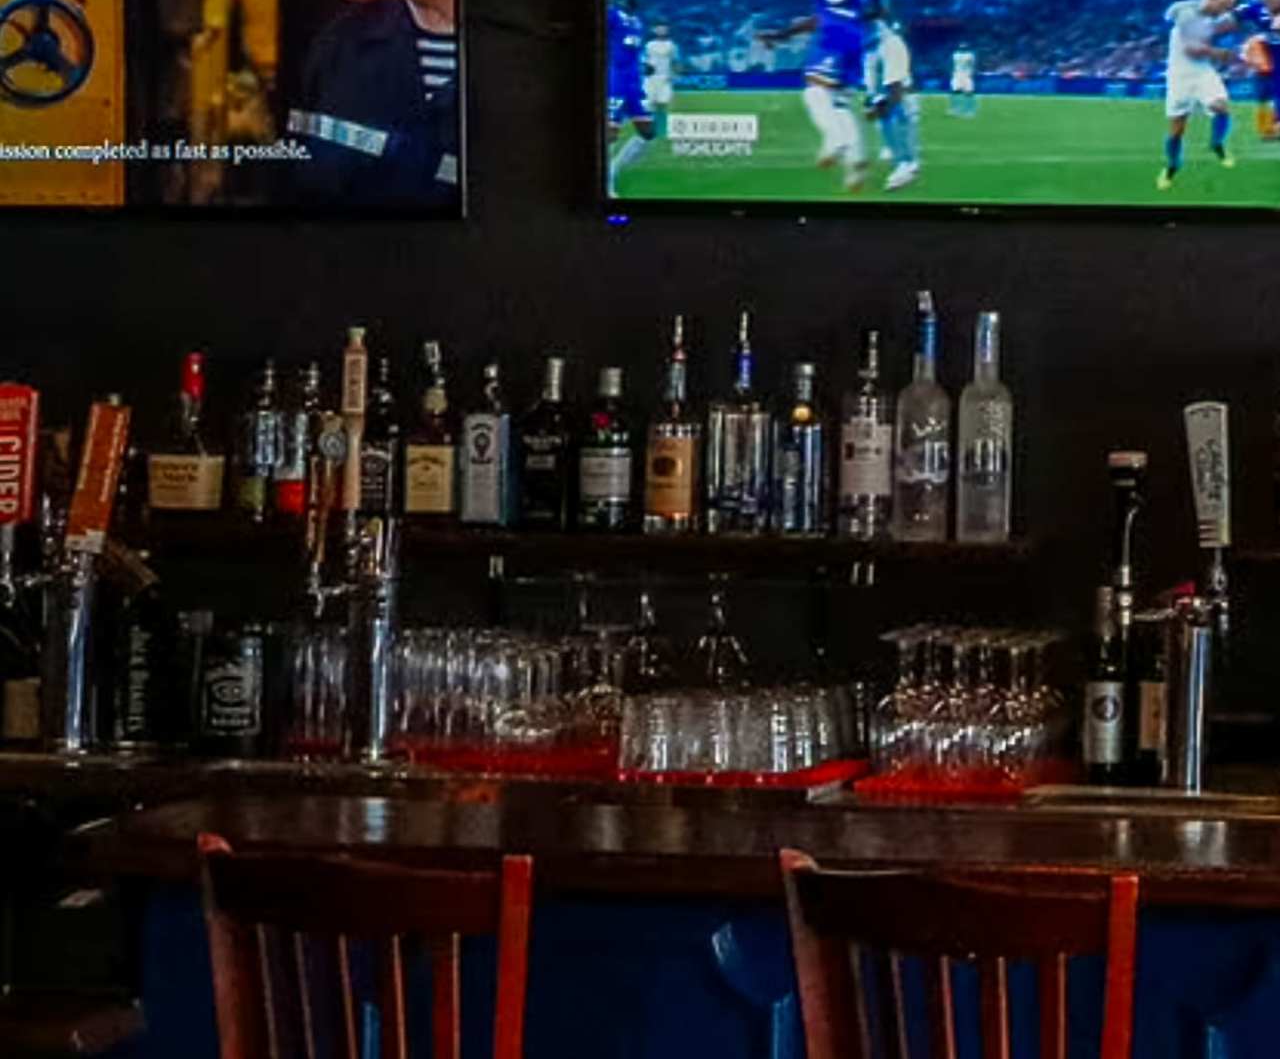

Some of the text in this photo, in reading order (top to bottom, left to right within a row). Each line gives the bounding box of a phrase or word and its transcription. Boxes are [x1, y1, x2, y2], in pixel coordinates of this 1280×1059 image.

[55, 139, 147, 163] completed
[151, 144, 170, 158] as
[175, 140, 206, 158] fast
[211, 144, 229, 158] as
[234, 140, 311, 163] possible.
[0, 435, 22, 515] CIDER
